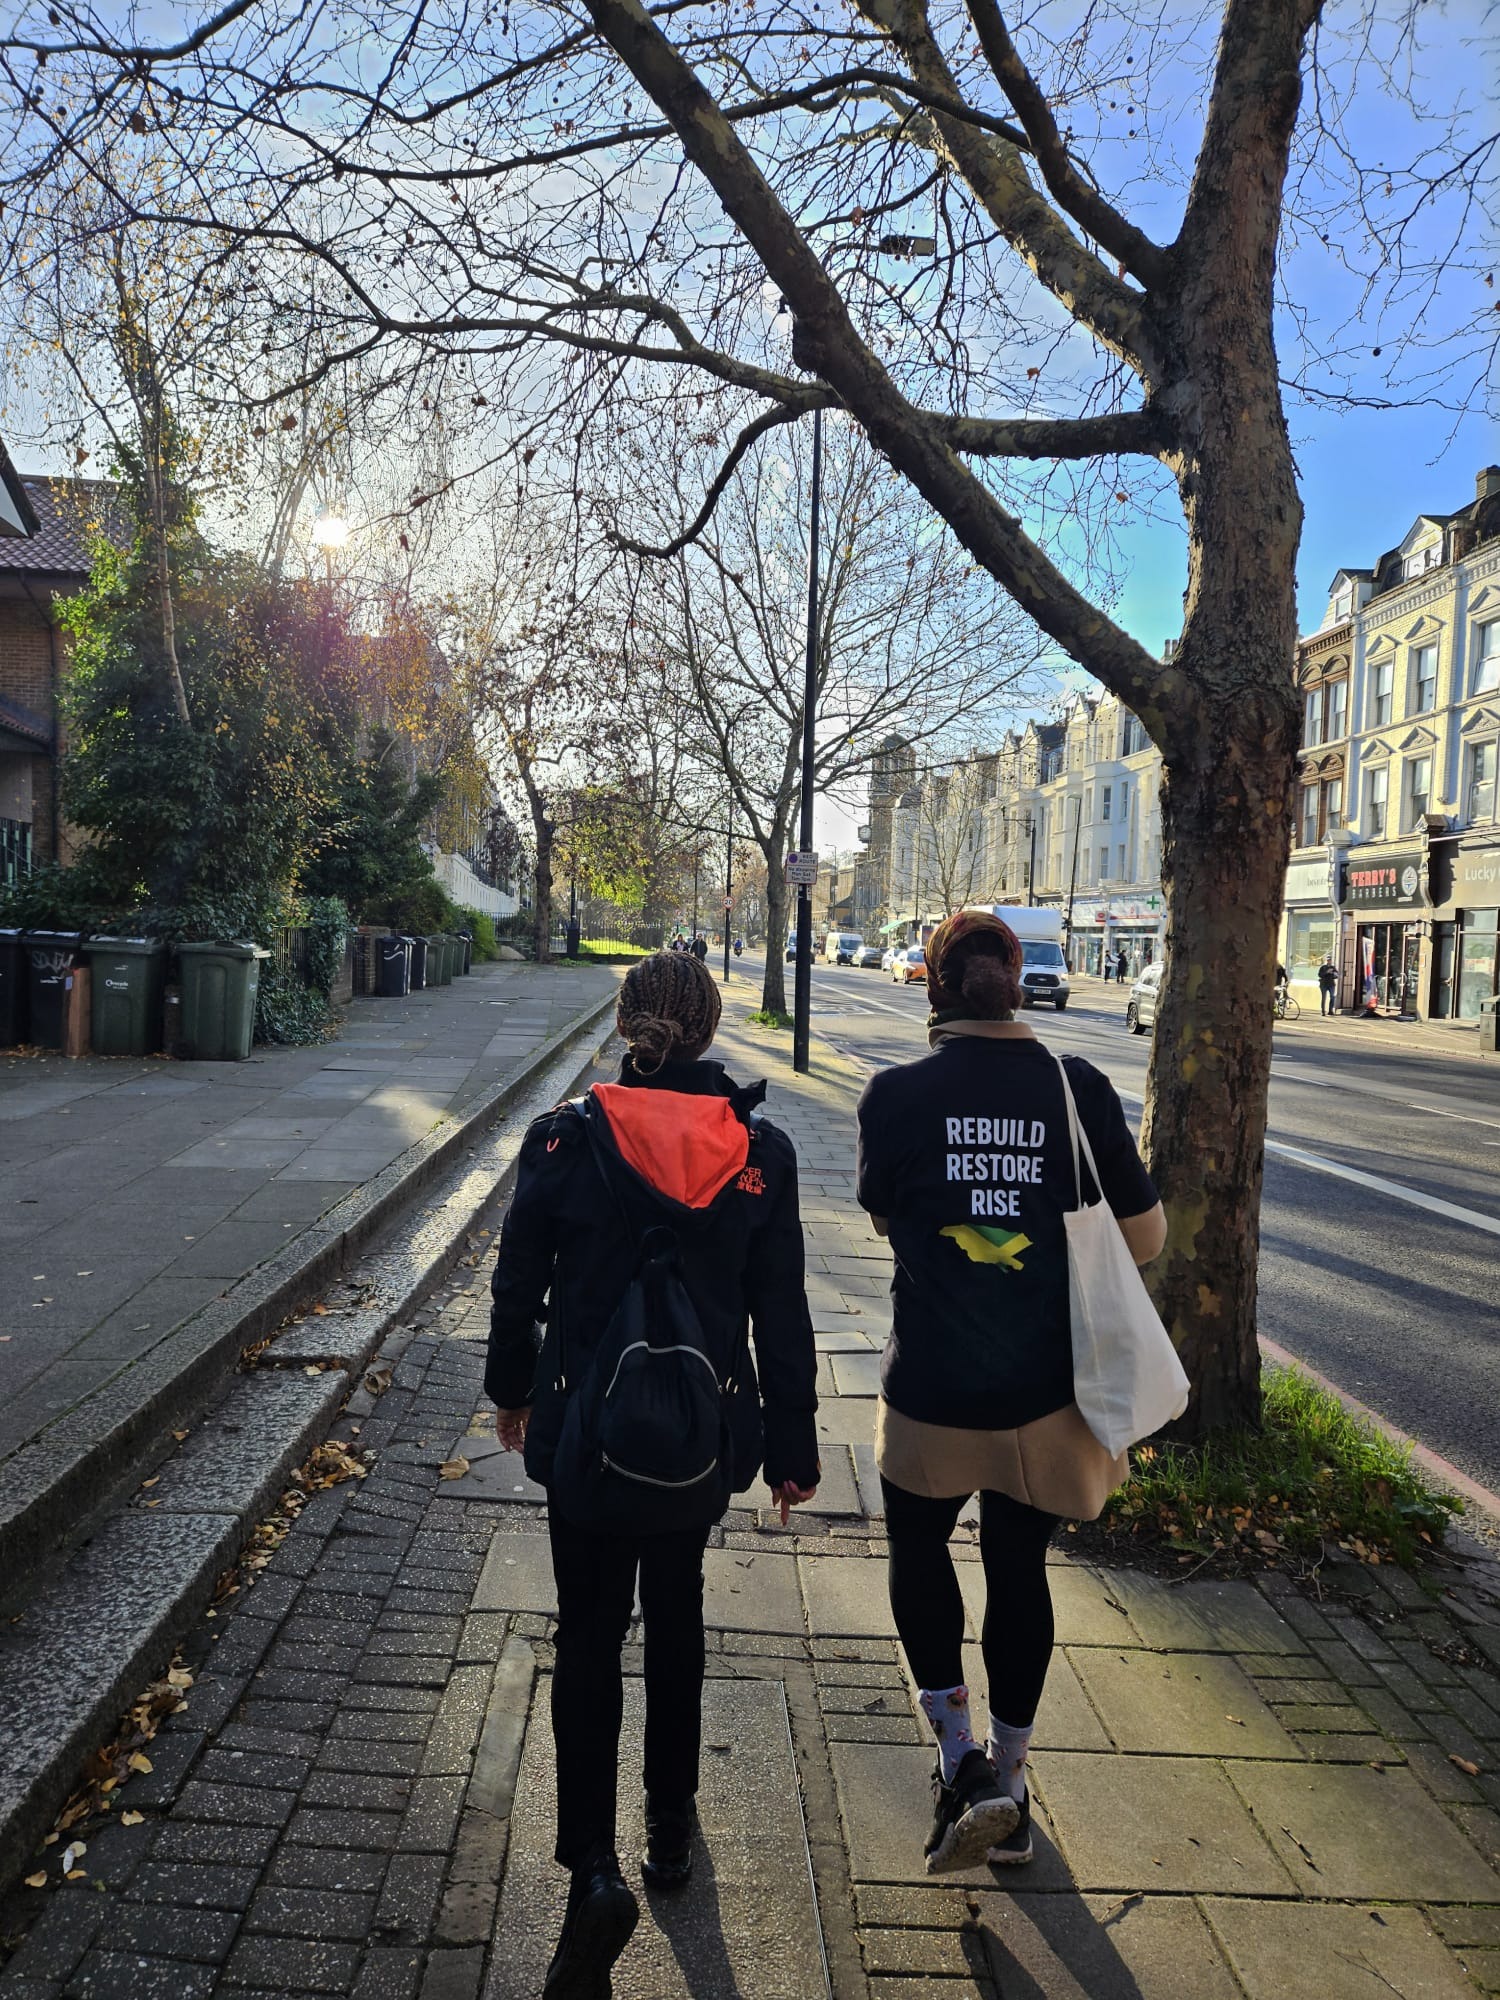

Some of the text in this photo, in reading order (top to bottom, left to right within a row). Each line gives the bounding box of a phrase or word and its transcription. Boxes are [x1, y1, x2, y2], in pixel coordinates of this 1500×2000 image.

[1351, 868, 1397, 887] TERRY'S
[1465, 864, 1496, 883] Lucky
[1352, 886, 1397, 899] BARBERS
[946, 1117, 1046, 1148] REBUILD
[946, 1153, 1044, 1183] RESTORE
[971, 1189, 1021, 1216] RISE
